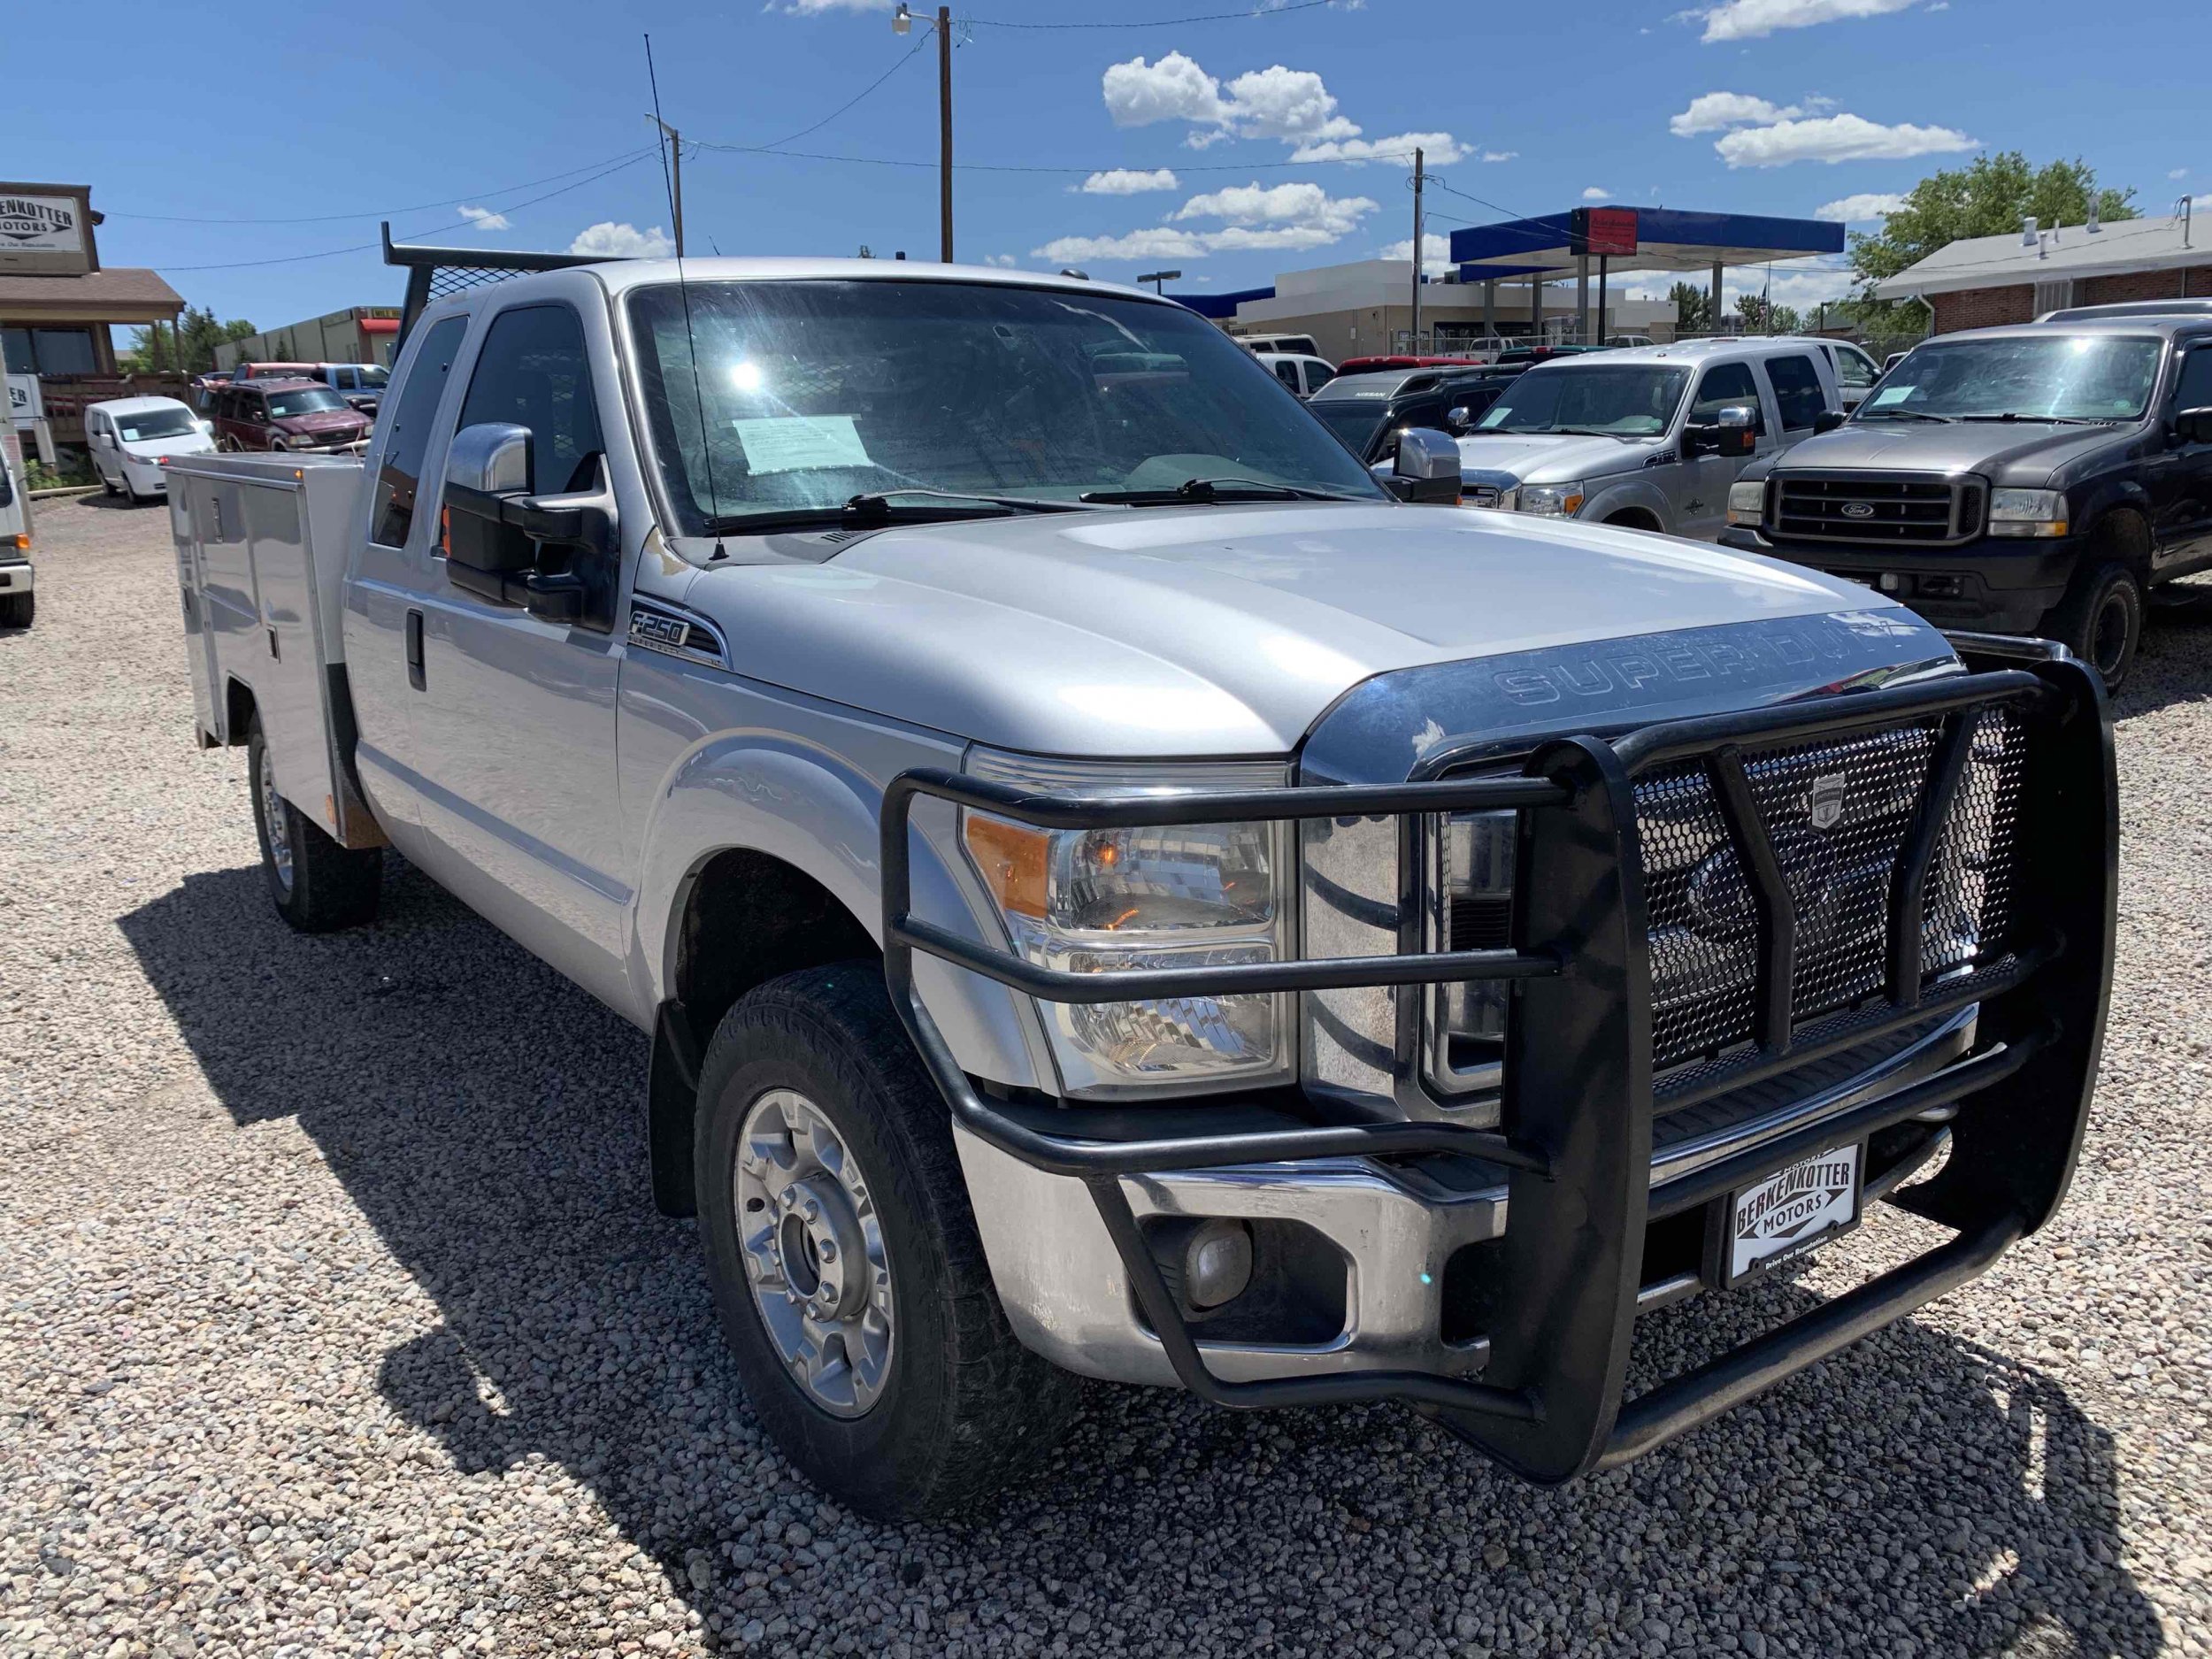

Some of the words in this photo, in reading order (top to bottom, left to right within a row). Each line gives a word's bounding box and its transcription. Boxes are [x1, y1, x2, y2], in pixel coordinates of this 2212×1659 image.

[0, 221, 47, 231] OTORS
[1493, 643, 1755, 706] SUPER
[1736, 1162, 1850, 1236] BERKENKOTTER
[1763, 1194, 1822, 1234] MOTORS
[1765, 1258, 1782, 1271] Drive
[1782, 1252, 1794, 1262] Our
[1794, 1235, 1829, 1256] Reputation
